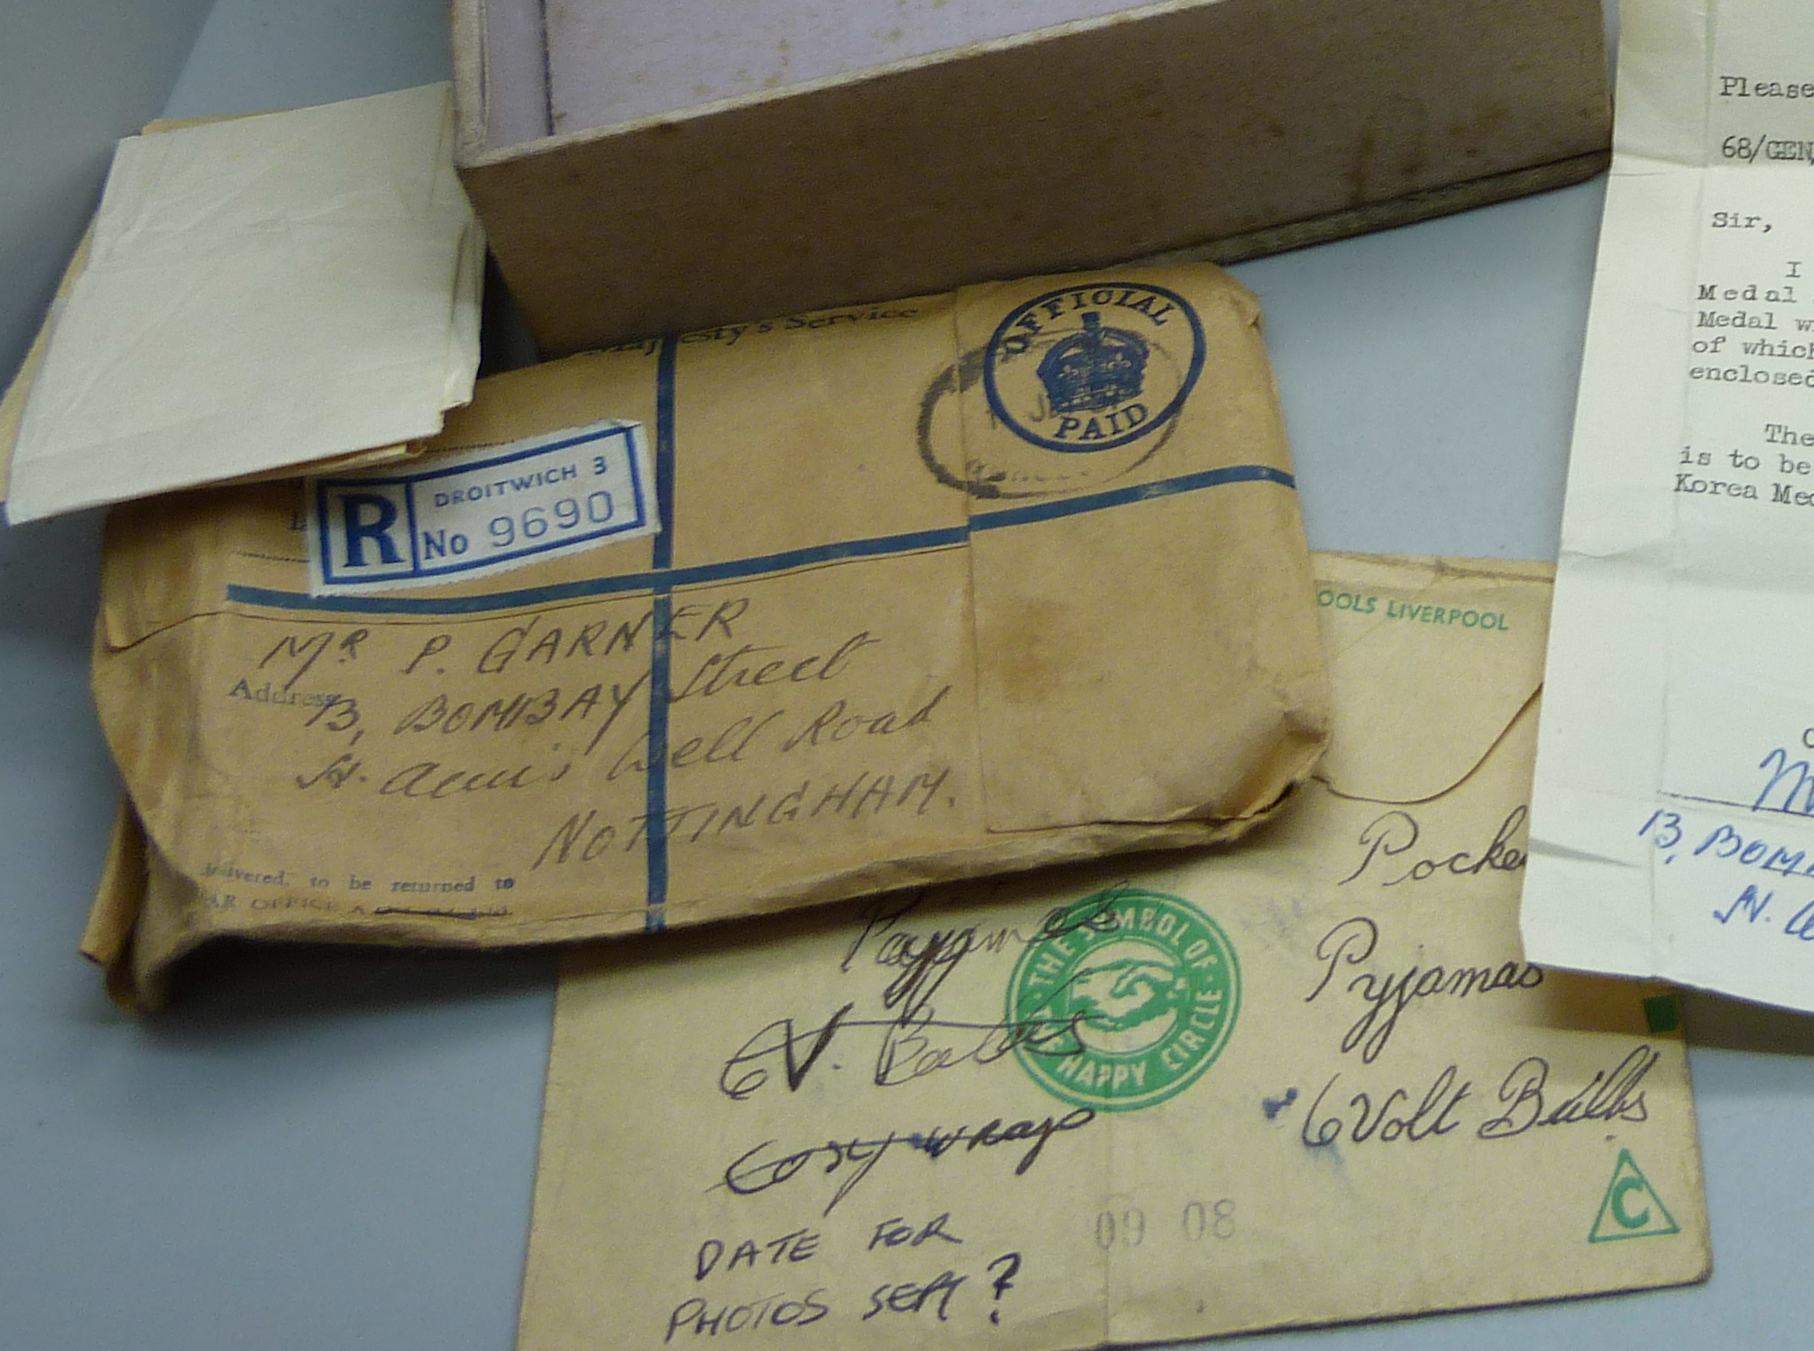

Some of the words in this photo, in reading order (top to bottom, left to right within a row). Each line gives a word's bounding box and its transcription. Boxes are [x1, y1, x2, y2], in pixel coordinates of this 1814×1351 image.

[1711, 211, 1774, 233] Sir,
[1697, 284, 1798, 303] Medal
[1785, 261, 1802, 279] I
[785, 305, 919, 331] Service
[1002, 289, 1175, 354] OFFICIAL
[1696, 310, 1778, 331] Medal
[1692, 335, 1726, 355] of
[1054, 403, 1149, 441] PAID
[435, 462, 578, 508] DROITWICH
[593, 455, 608, 476] 3
[1673, 473, 1759, 500] Korea
[1679, 446, 1712, 467] is
[1728, 449, 1760, 471] to
[1779, 453, 1811, 476] be
[342, 492, 405, 568] R
[424, 530, 468, 561] No
[489, 490, 615, 548] 9690
[476, 597, 750, 675] GARNER
[1387, 600, 1510, 631] LIVERPOOL
[394, 669, 652, 756] BOMBAY
[668, 630, 883, 704] Street
[606, 710, 785, 781] Well
[782, 686, 952, 752] Road
[310, 875, 330, 889] to
[350, 874, 372, 891] be
[391, 876, 476, 893] returned
[495, 877, 516, 890] to
[1029, 936, 1076, 987] THE
[1184, 938, 1219, 970] OF
[1304, 917, 1546, 1064] Pyjamas
[1056, 1054, 1149, 1090] HAPPY
[1160, 989, 1224, 1070] CIRCLE
[1477, 1044, 1661, 1141] Bulbs
[1611, 1176, 1651, 1229] C
[696, 1226, 821, 1282] DATE
[869, 1211, 964, 1250] FOR
[664, 1286, 830, 1345] PHOTOS
